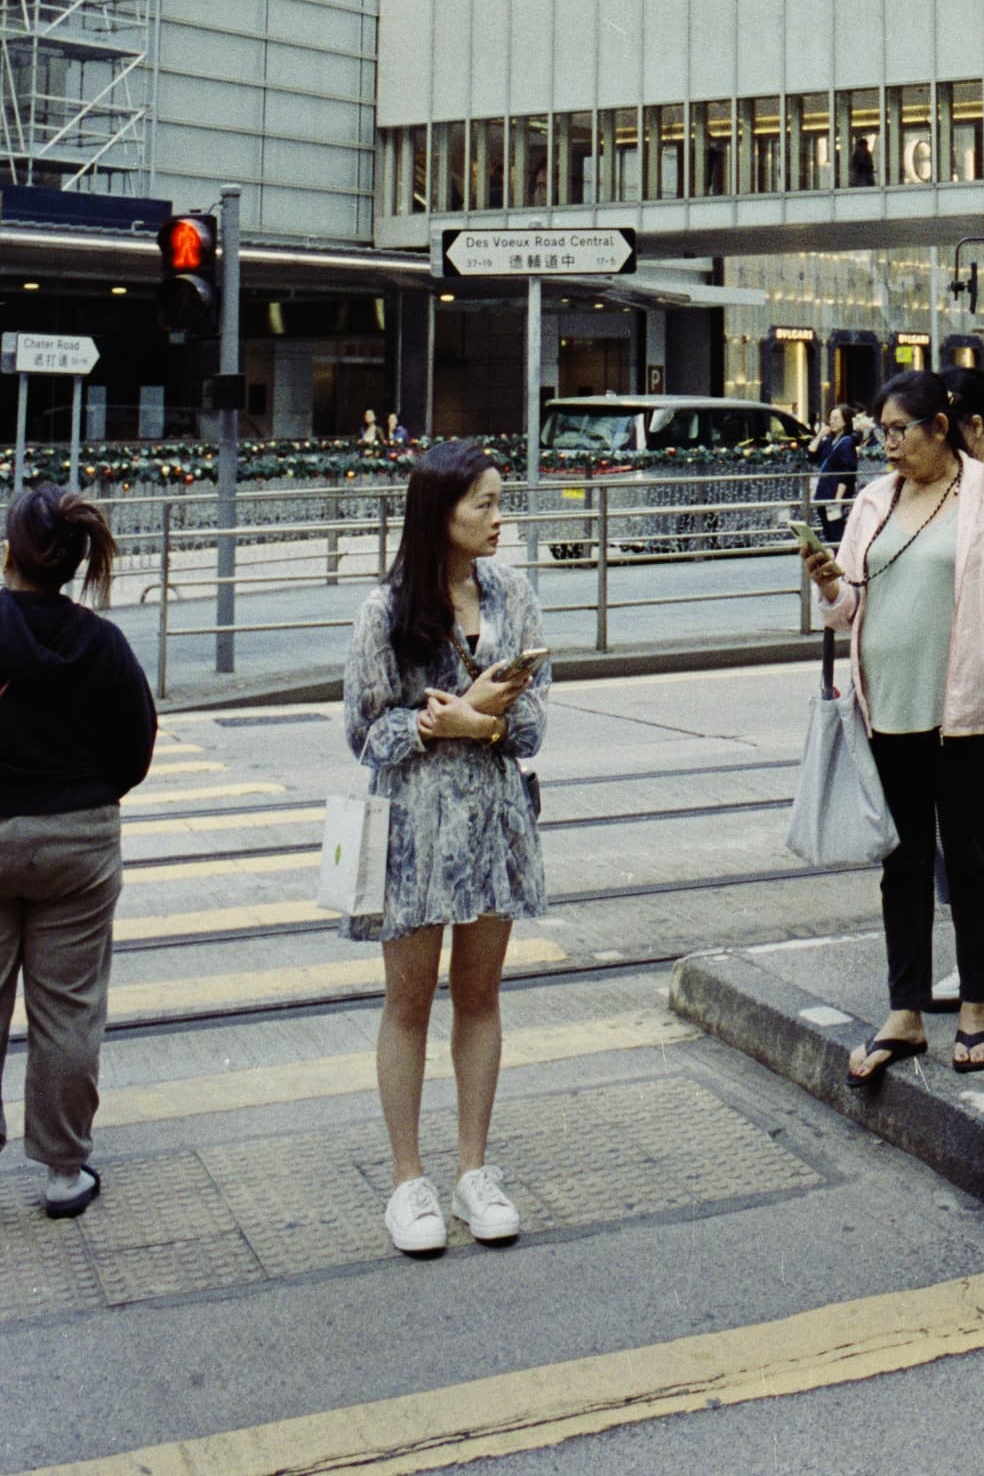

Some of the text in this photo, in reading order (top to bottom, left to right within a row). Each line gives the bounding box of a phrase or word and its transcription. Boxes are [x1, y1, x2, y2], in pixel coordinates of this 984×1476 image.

[466, 235, 614, 248] Des Voeux Road Central
[510, 253, 575, 269] 德輔道中
[24, 338, 80, 351] Chater Road
[651, 370, 660, 390] P
